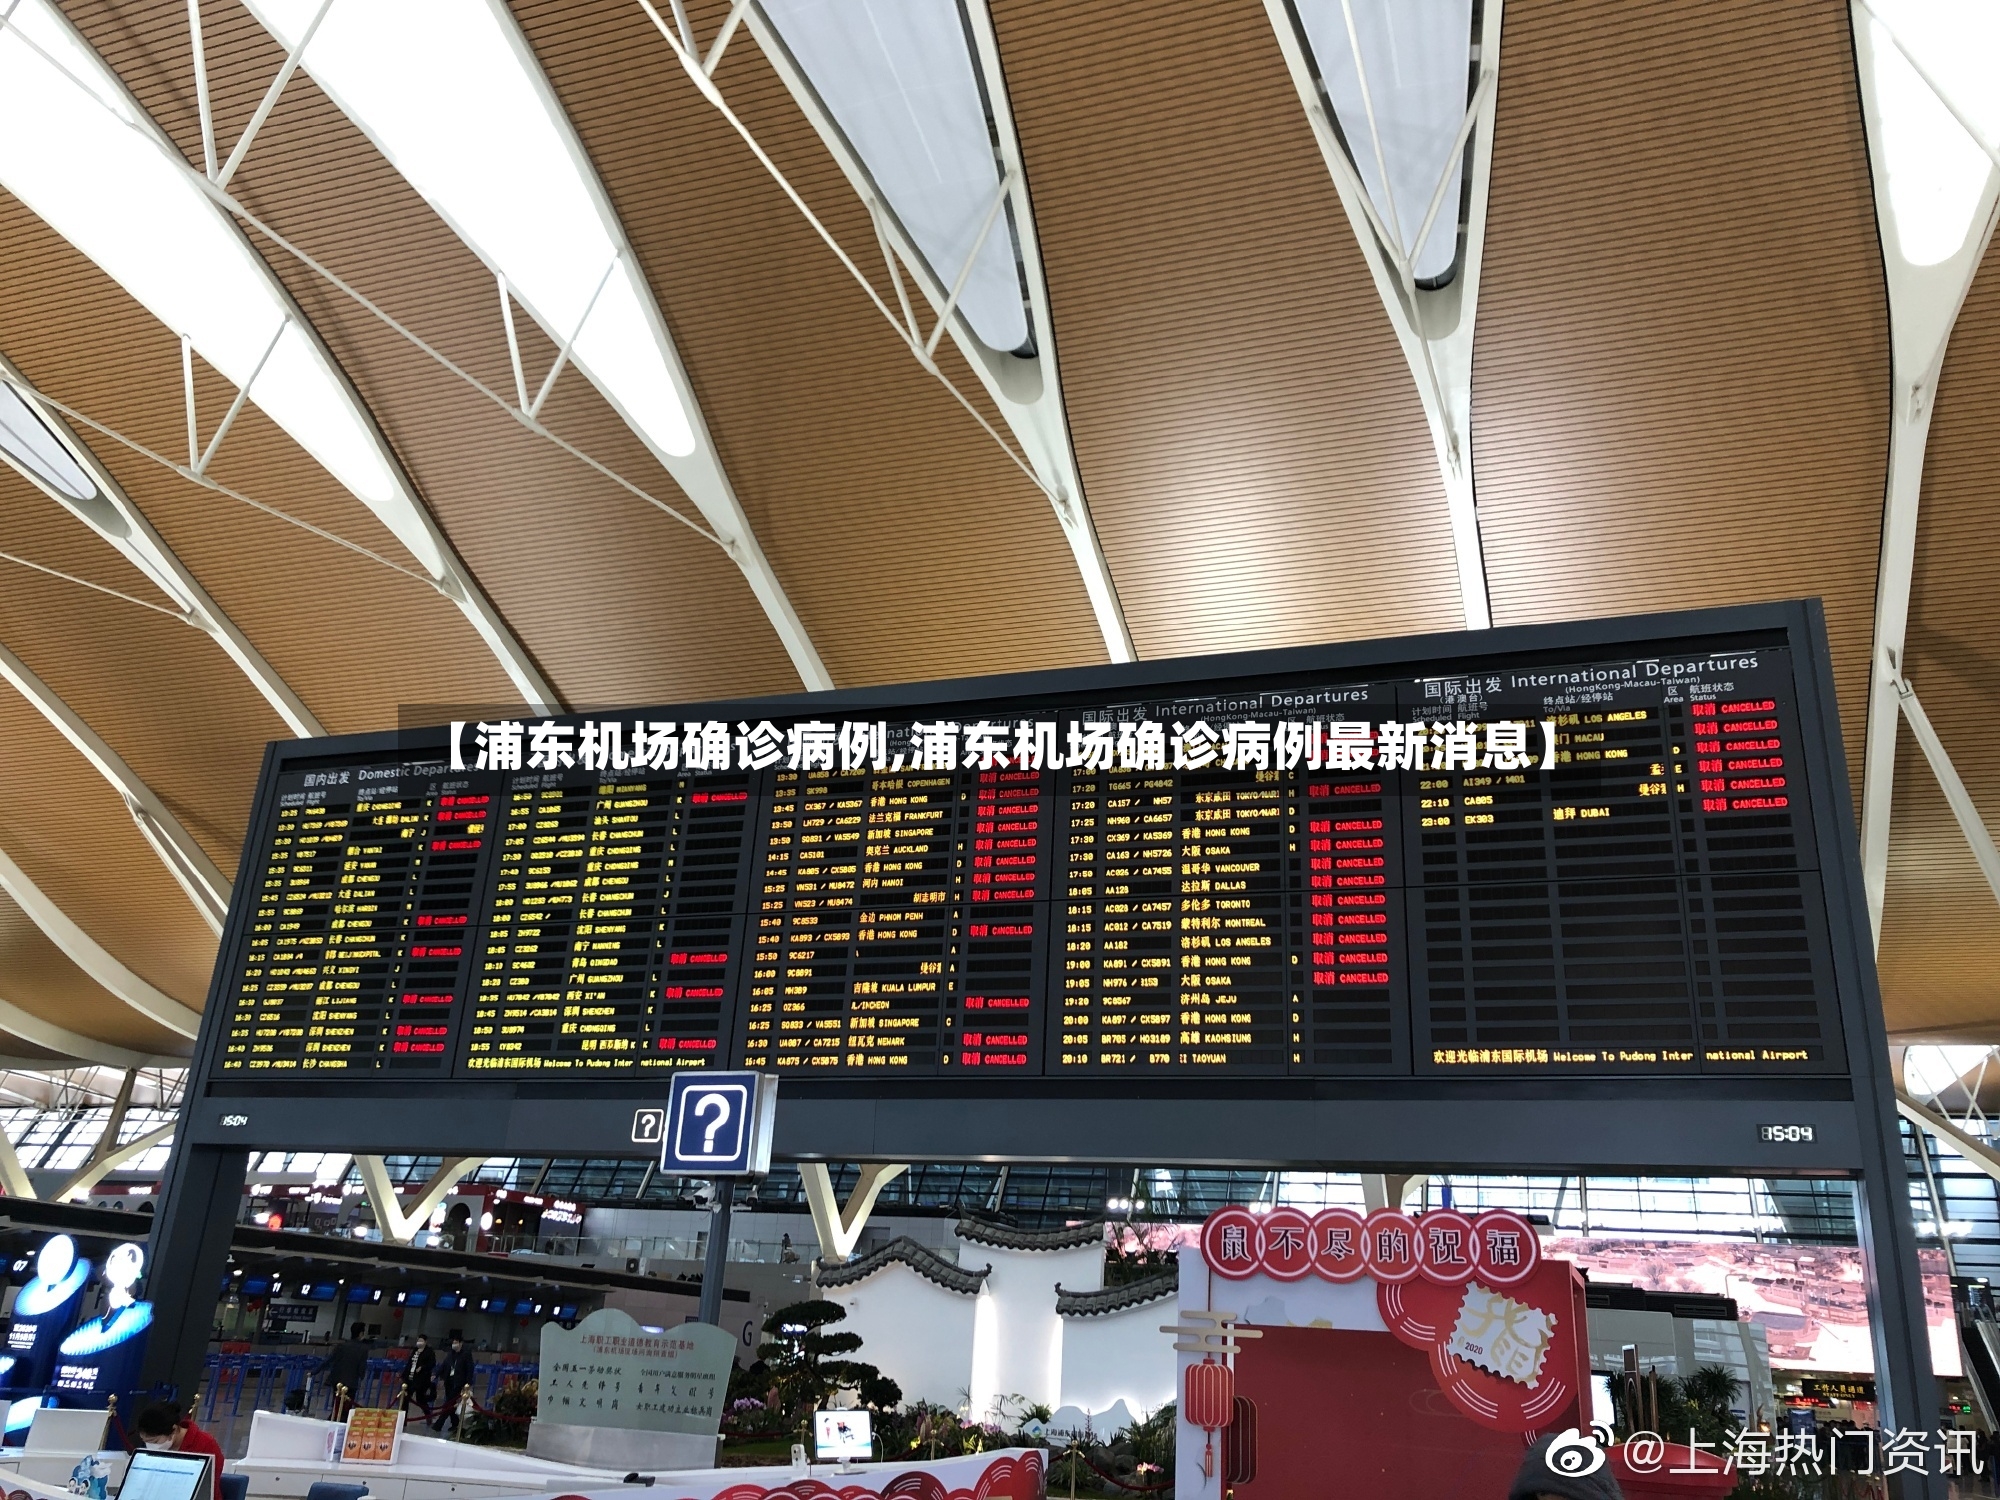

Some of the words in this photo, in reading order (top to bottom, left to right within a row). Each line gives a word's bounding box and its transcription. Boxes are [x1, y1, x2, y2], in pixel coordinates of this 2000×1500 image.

[1425, 676, 1502, 698] 国际出发
[1511, 665, 1637, 688] International
[1646, 656, 1759, 677] Departures
[1565, 676, 1700, 693] (HongKong-Macau-Taiwan)
[1668, 686, 1679, 696] 区
[1689, 683, 1735, 694] 航班状态
[1543, 692, 1613, 705] 终点站/经停站
[1664, 696, 1684, 704] Area
[1690, 694, 1717, 702] Status
[1082, 706, 1148, 725] 国际出发
[1156, 694, 1263, 717] International
[1271, 689, 1369, 707] Departures
[1411, 705, 1452, 716] 计划时间
[1457, 702, 1488, 713] 航班号
[1543, 705, 1571, 714] To/Via
[1607, 711, 1647, 721] ANGELES
[1691, 702, 1716, 716] 取消
[1721, 701, 1775, 713] CANCELLED
[1413, 714, 1452, 723] Scheduled
[1458, 712, 1480, 721] Flight
[1694, 722, 1718, 736] 取消
[1723, 720, 1778, 732] CANCELLED
[1605, 749, 1628, 758] KONG
[1695, 740, 1720, 754] 取消
[1725, 739, 1780, 751] CANCELLED
[1698, 759, 1723, 773] 取消
[1727, 758, 1783, 770] CANCELLED
[303, 770, 350, 787] 国内出发
[358, 764, 410, 781] Domestic
[908, 779, 950, 787] COPENHAGEN
[1000, 772, 1039, 781] CANCELLED
[889, 797, 907, 805] HONG
[1000, 789, 1039, 798] CANCELLED
[1072, 801, 1095, 810] 17:20
[1108, 799, 1131, 808] CA157
[1335, 784, 1381, 794] CANCELLED
[1421, 798, 1449, 808] 22:10
[1700, 778, 1725, 793] 取消
[1730, 777, 1785, 790] CANCELLED
[905, 811, 943, 820] FRANKFURT
[998, 805, 1038, 814] CANCELLED
[1553, 807, 1576, 820] 迪拜
[1580, 808, 1610, 818] DUBAI
[1702, 798, 1727, 812] 取消
[1732, 797, 1788, 809] CANCELLED
[1072, 818, 1094, 827] 17:25
[895, 828, 933, 837] SINGAPORE
[998, 822, 1037, 832] CANCELLED
[1182, 827, 1201, 839] 香港
[1205, 829, 1226, 837] HONG
[1230, 827, 1250, 836] KONG
[1335, 820, 1383, 831] CANCELLED
[893, 845, 928, 853] AUCKLAND
[997, 838, 1036, 848] CANCELLED
[1182, 845, 1201, 857] 大阪
[1205, 846, 1230, 855] OSAKA
[996, 856, 1036, 866] CANCELLED
[1181, 863, 1211, 875] 温哥华
[1215, 863, 1260, 873] VANCOUVER
[862, 878, 878, 888] 河内
[882, 879, 903, 887] HANOI
[1215, 881, 1246, 890] DALLAS
[1336, 875, 1385, 886] CANCELLED
[913, 891, 946, 903] 胡志明市
[1181, 898, 1211, 911] 多伦多
[1216, 900, 1250, 909] TORONTO
[860, 912, 875, 923] 金边
[879, 913, 901, 921] PHNOM
[1225, 918, 1266, 928] MONTREAL
[1181, 936, 1211, 949] 洛杉矶
[1215, 938, 1231, 947] LOS
[1236, 937, 1271, 946] ANGELES
[1338, 933, 1387, 944] CANCELLED
[690, 952, 728, 964] CANCELLED
[882, 984, 904, 992] KUALA
[908, 983, 936, 992] LUMPUR
[1180, 993, 1210, 1005] 济州岛
[1215, 995, 1237, 1004] JEJU
[879, 1018, 919, 1028] SINGAPORE
[1180, 1031, 1200, 1044] 高雄
[1205, 1034, 1251, 1043] KAOHSIUNG
[1293, 1034, 1299, 1042] H
[868, 1056, 886, 1065] HONG
[889, 1056, 907, 1065] KONG
[944, 1055, 949, 1064] D
[984, 1054, 1027, 1065] CANCELLED
[1192, 1054, 1226, 1063] TAOYUAN
[1434, 1049, 1548, 1064] 欢迎光临浦东国际机场
[1553, 1052, 1596, 1062] Welcome
[1602, 1052, 1615, 1061] To
[1620, 1051, 1656, 1062] Pudong
[1662, 1051, 1693, 1061] Inter
[1706, 1050, 1755, 1060] national
[1762, 1050, 1807, 1060] Airport
[467, 1057, 541, 1070] 欢迎光临浦东国际机场
[543, 1059, 572, 1068] Welcome
[586, 1059, 611, 1068] Pudong
[614, 1059, 632, 1067] Inter
[222, 1114, 248, 1126] 15:04
[1766, 1125, 1813, 1141] 15:04
[1221, 1224, 1521, 1266] 鼠不尽的祝福
[272, 1282, 282, 1293] 11
[301, 1284, 311, 1295] 12
[742, 1320, 754, 1347] G
[1464, 1341, 1484, 1355] 2020
